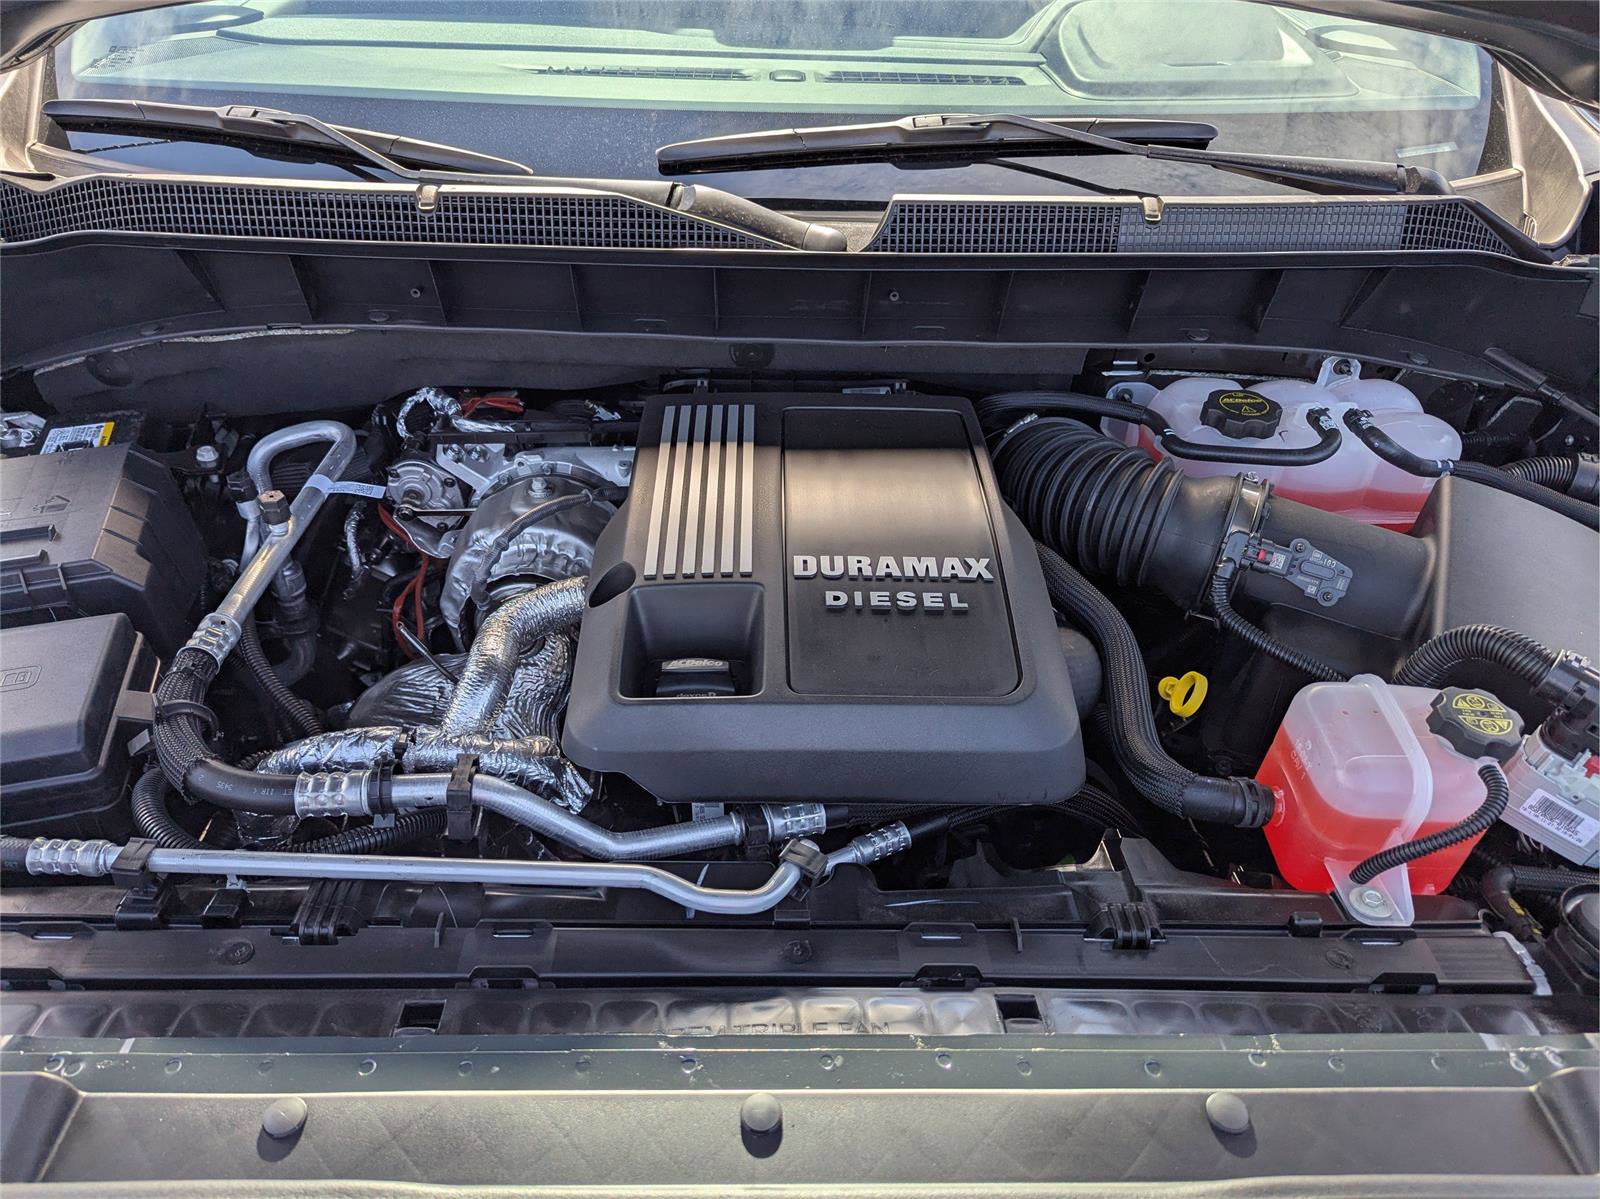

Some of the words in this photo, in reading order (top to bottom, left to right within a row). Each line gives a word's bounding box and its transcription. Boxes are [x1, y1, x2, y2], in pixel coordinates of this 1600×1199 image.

[793, 555, 993, 582] DURAMAX
[824, 591, 969, 611] DIESEL
[668, 659, 723, 669] ACDelco
